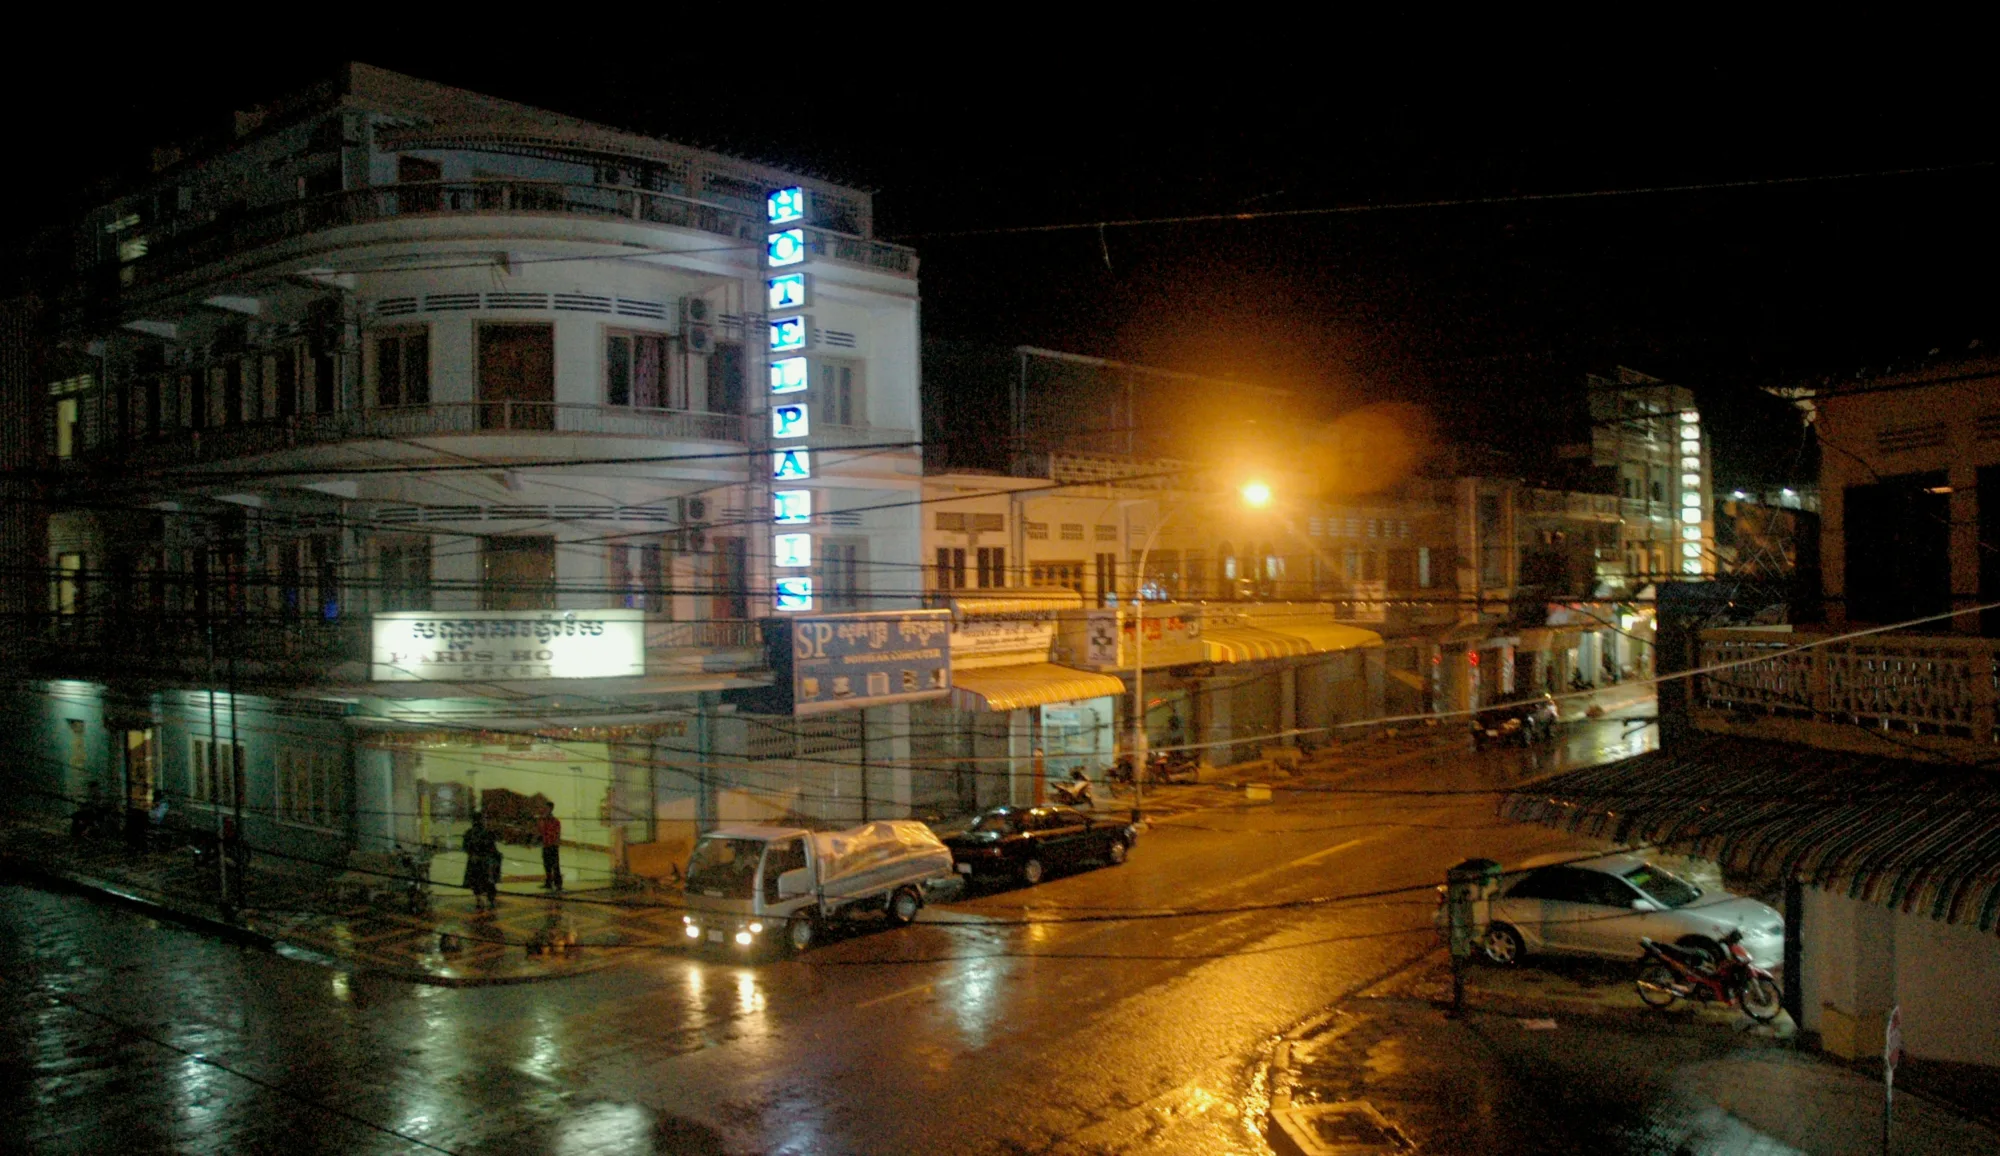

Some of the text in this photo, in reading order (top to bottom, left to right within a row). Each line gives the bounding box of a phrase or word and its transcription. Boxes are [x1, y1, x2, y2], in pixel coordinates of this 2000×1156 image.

[768, 188, 811, 611] HOTEL PARIS
[797, 622, 833, 659] SP
